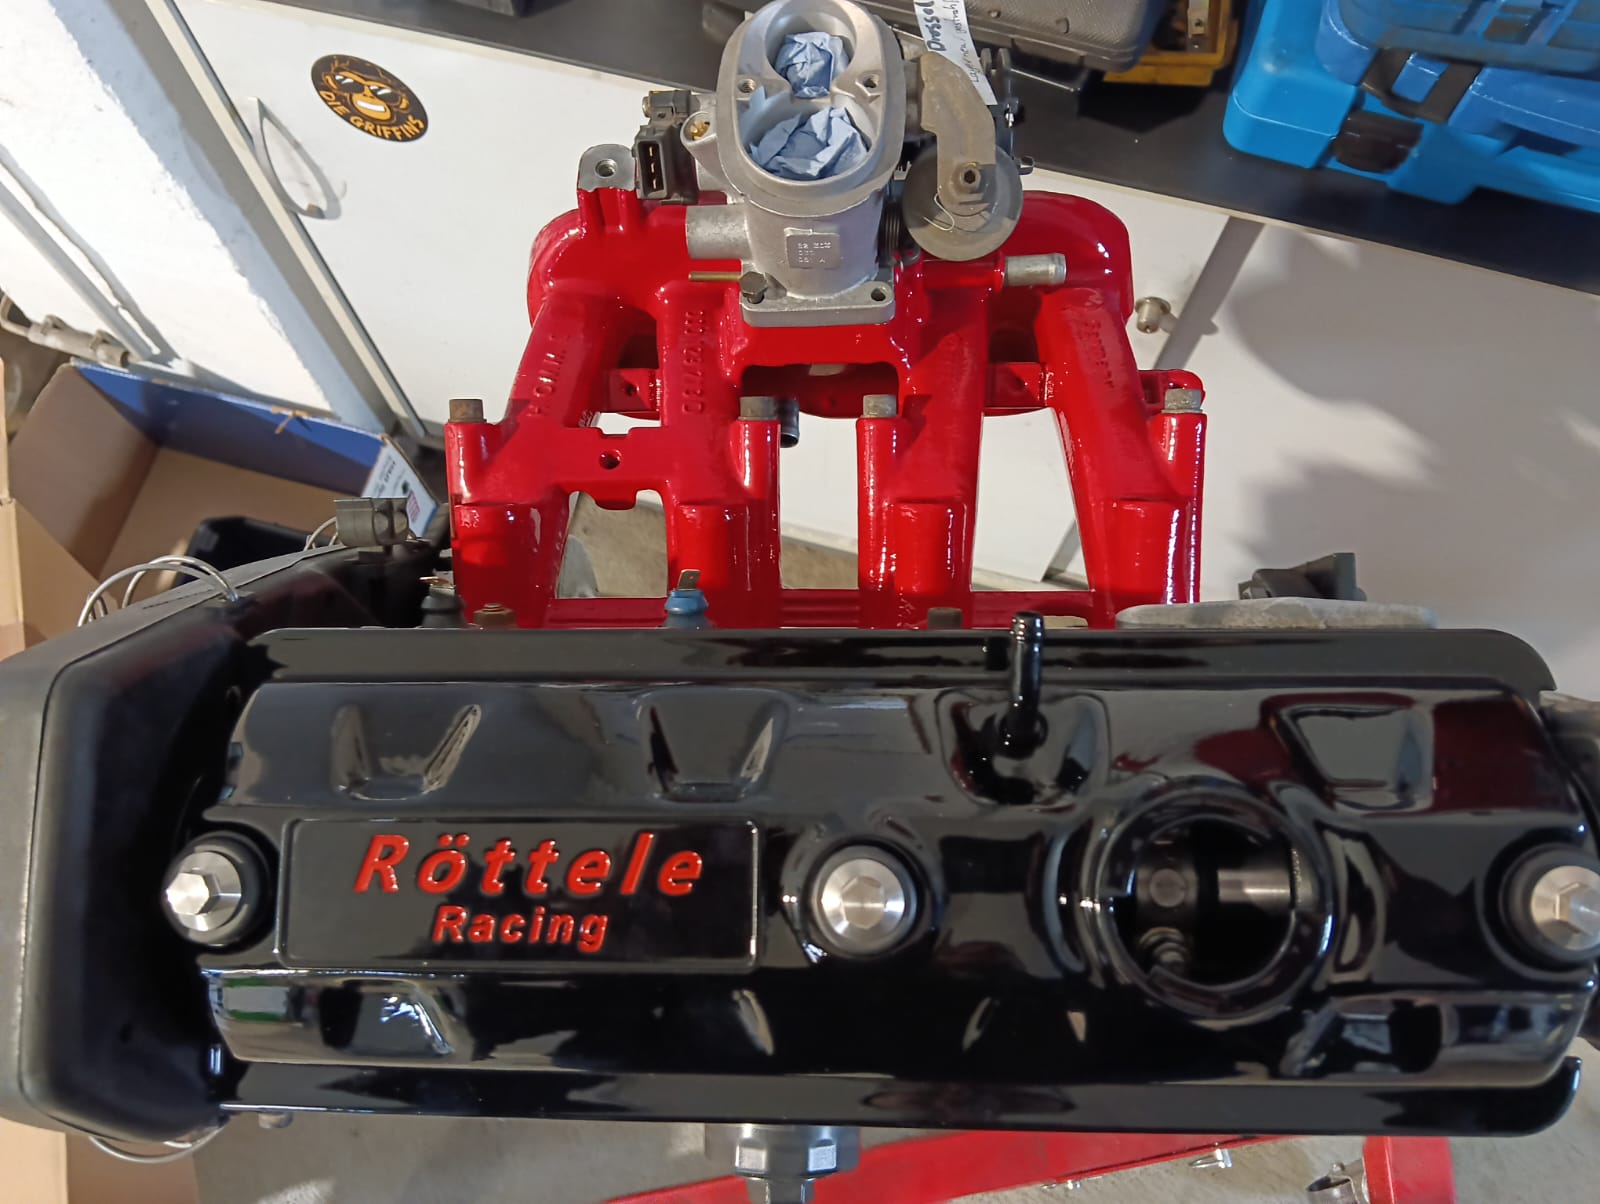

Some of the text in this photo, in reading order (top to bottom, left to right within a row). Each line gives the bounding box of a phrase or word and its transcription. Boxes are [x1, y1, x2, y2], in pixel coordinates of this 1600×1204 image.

[319, 90, 424, 141] DIE GRIFFINS
[353, 832, 704, 896] Röttele
[432, 905, 608, 952] Racing
